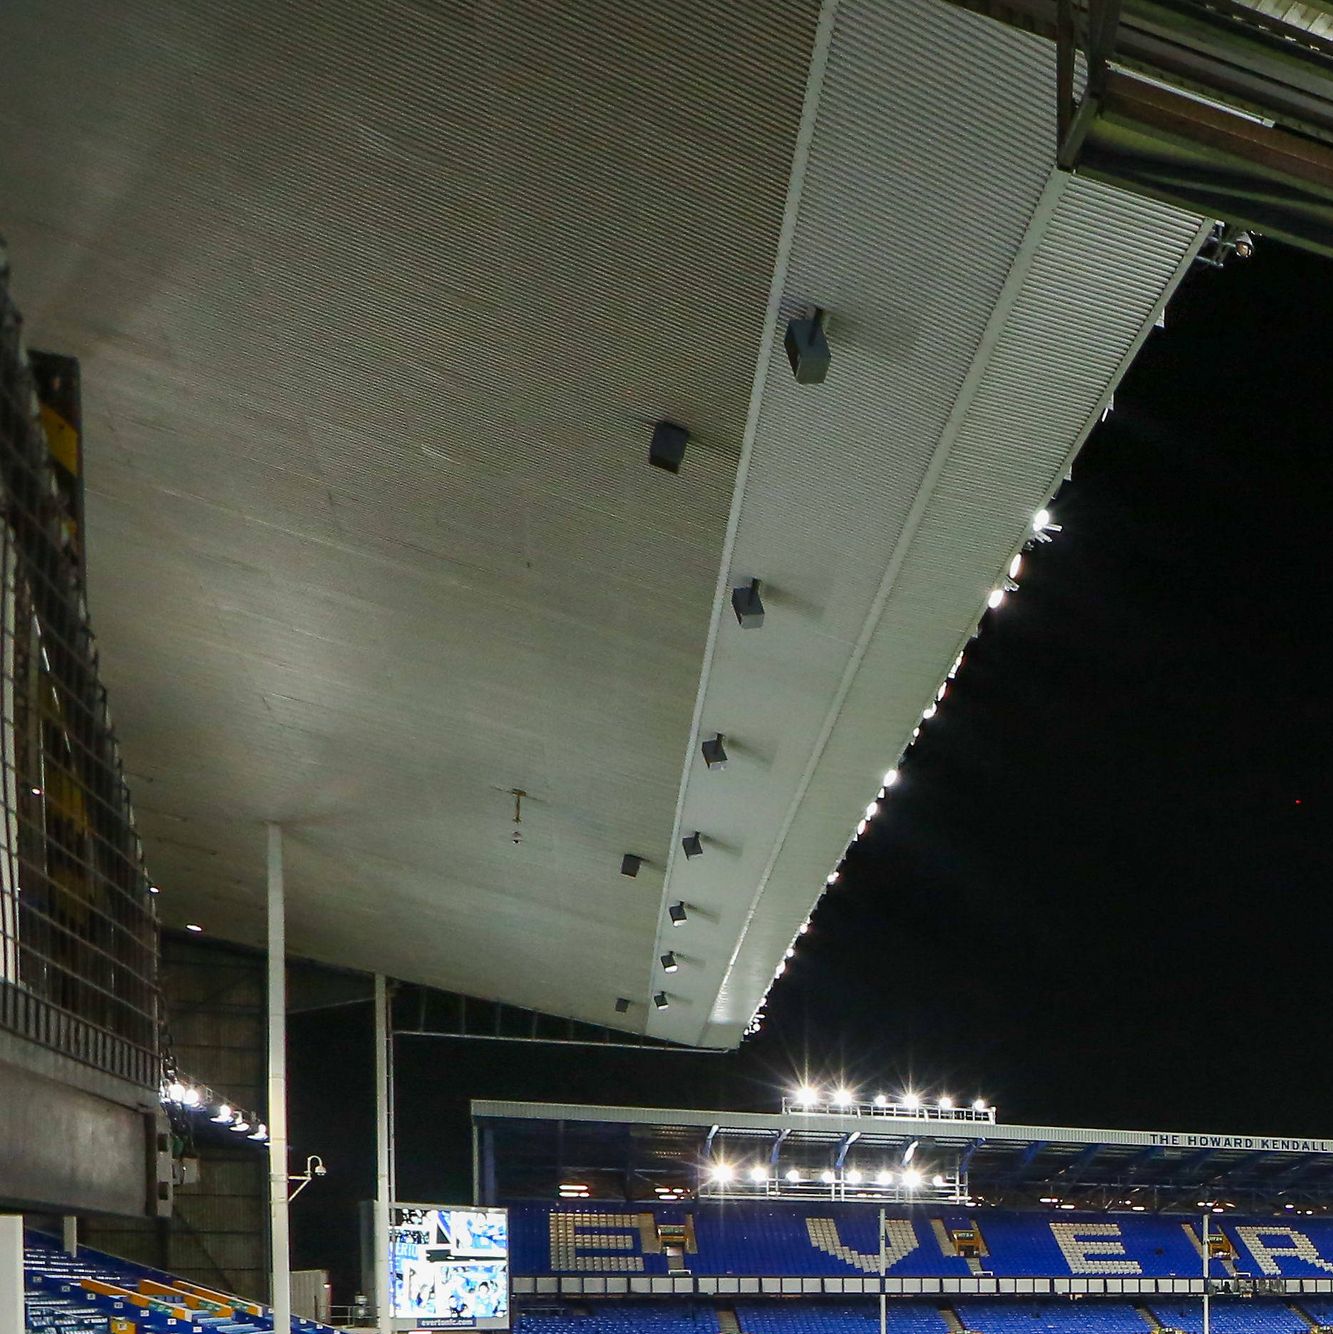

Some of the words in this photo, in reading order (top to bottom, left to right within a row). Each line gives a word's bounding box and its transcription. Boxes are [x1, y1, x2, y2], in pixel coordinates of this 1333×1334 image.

[1150, 1133, 1180, 1146] THE
[1187, 1135, 1254, 1150] HOWARD
[1261, 1138, 1328, 1153] KENDALL
